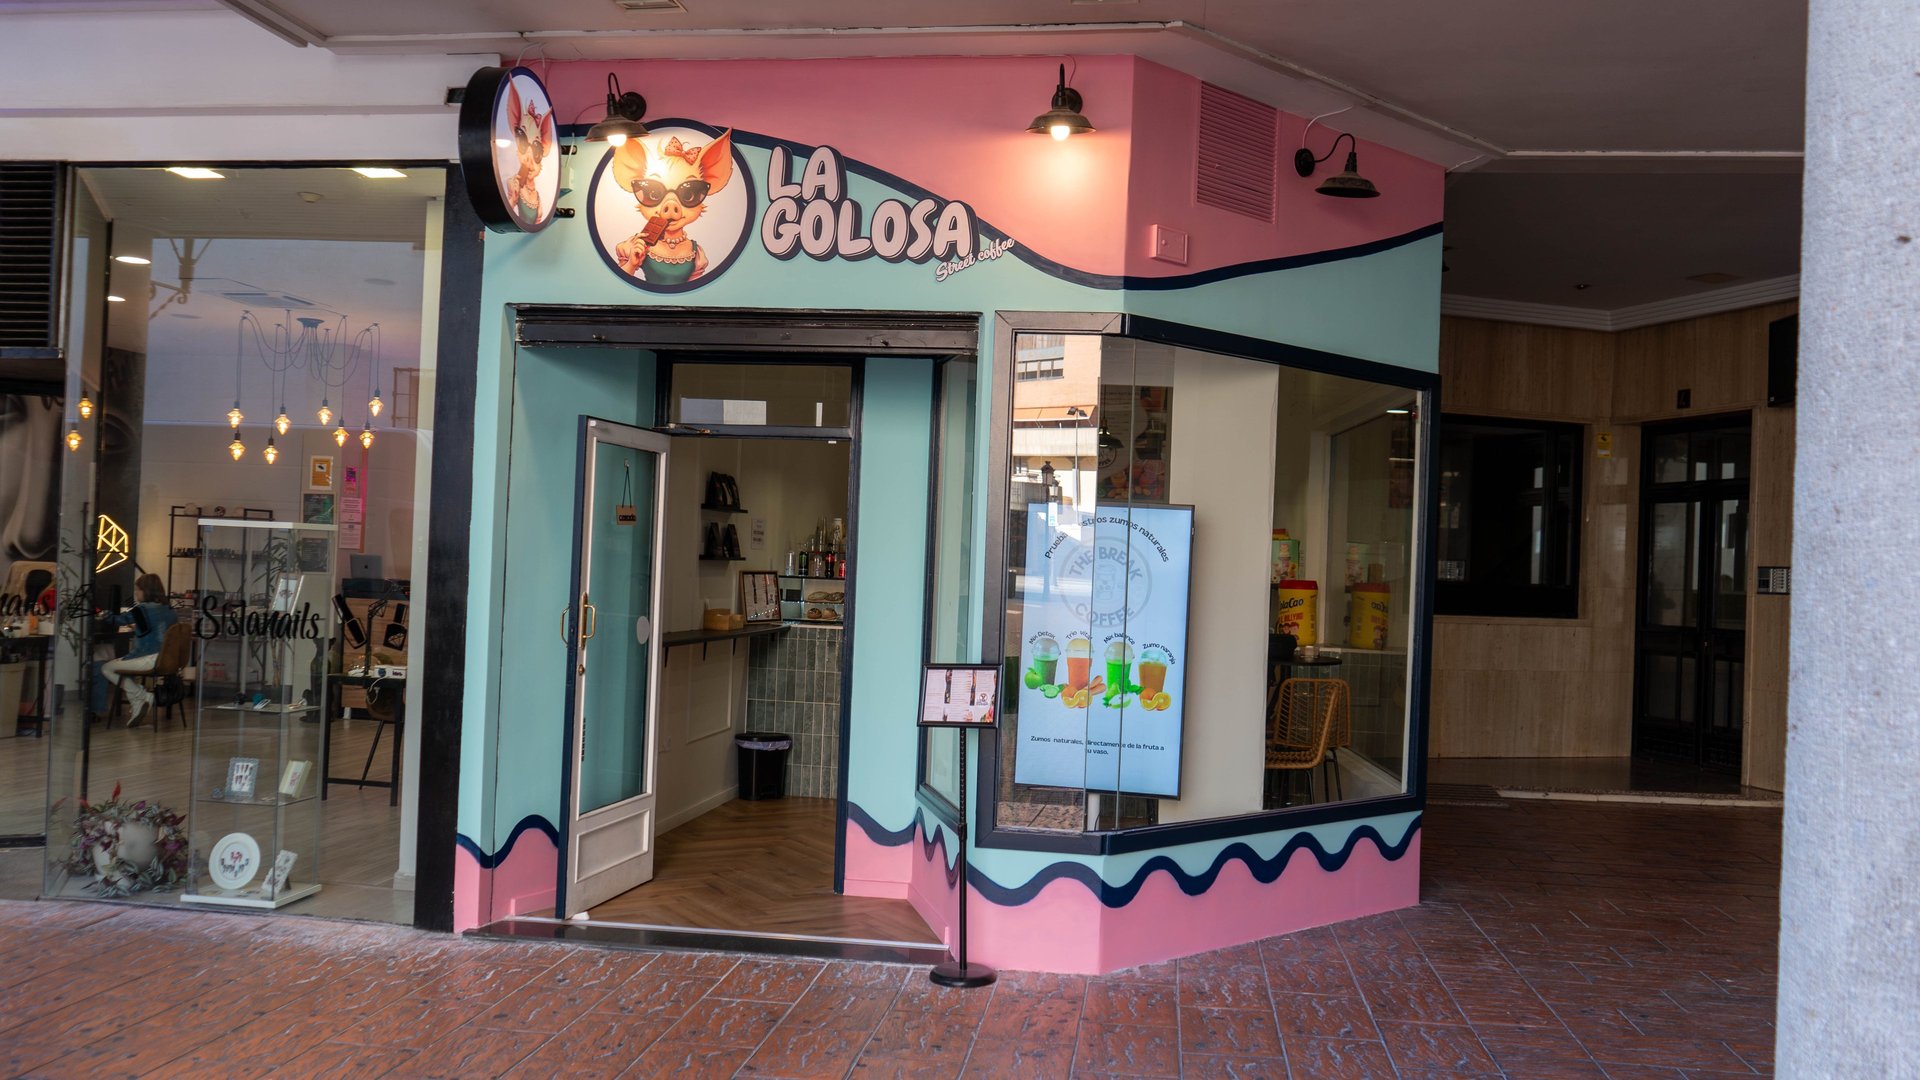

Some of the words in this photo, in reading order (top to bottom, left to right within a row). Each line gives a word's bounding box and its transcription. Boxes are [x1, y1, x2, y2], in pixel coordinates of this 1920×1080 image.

[767, 144, 847, 204] LA
[761, 196, 980, 263] GOLOSA
[935, 251, 976, 282] Street
[977, 238, 1015, 261] coffee
[1109, 517, 1138, 530] zumos
[1138, 527, 1170, 562] naturales
[1069, 550, 1093, 576] THE
[1099, 546, 1143, 581] BREAK
[1075, 603, 1135, 626] COFFEE
[1030, 735, 1051, 743] Zumos
[1087, 740, 1127, 748] irectamene
[1143, 743, 1159, 751] fruta
